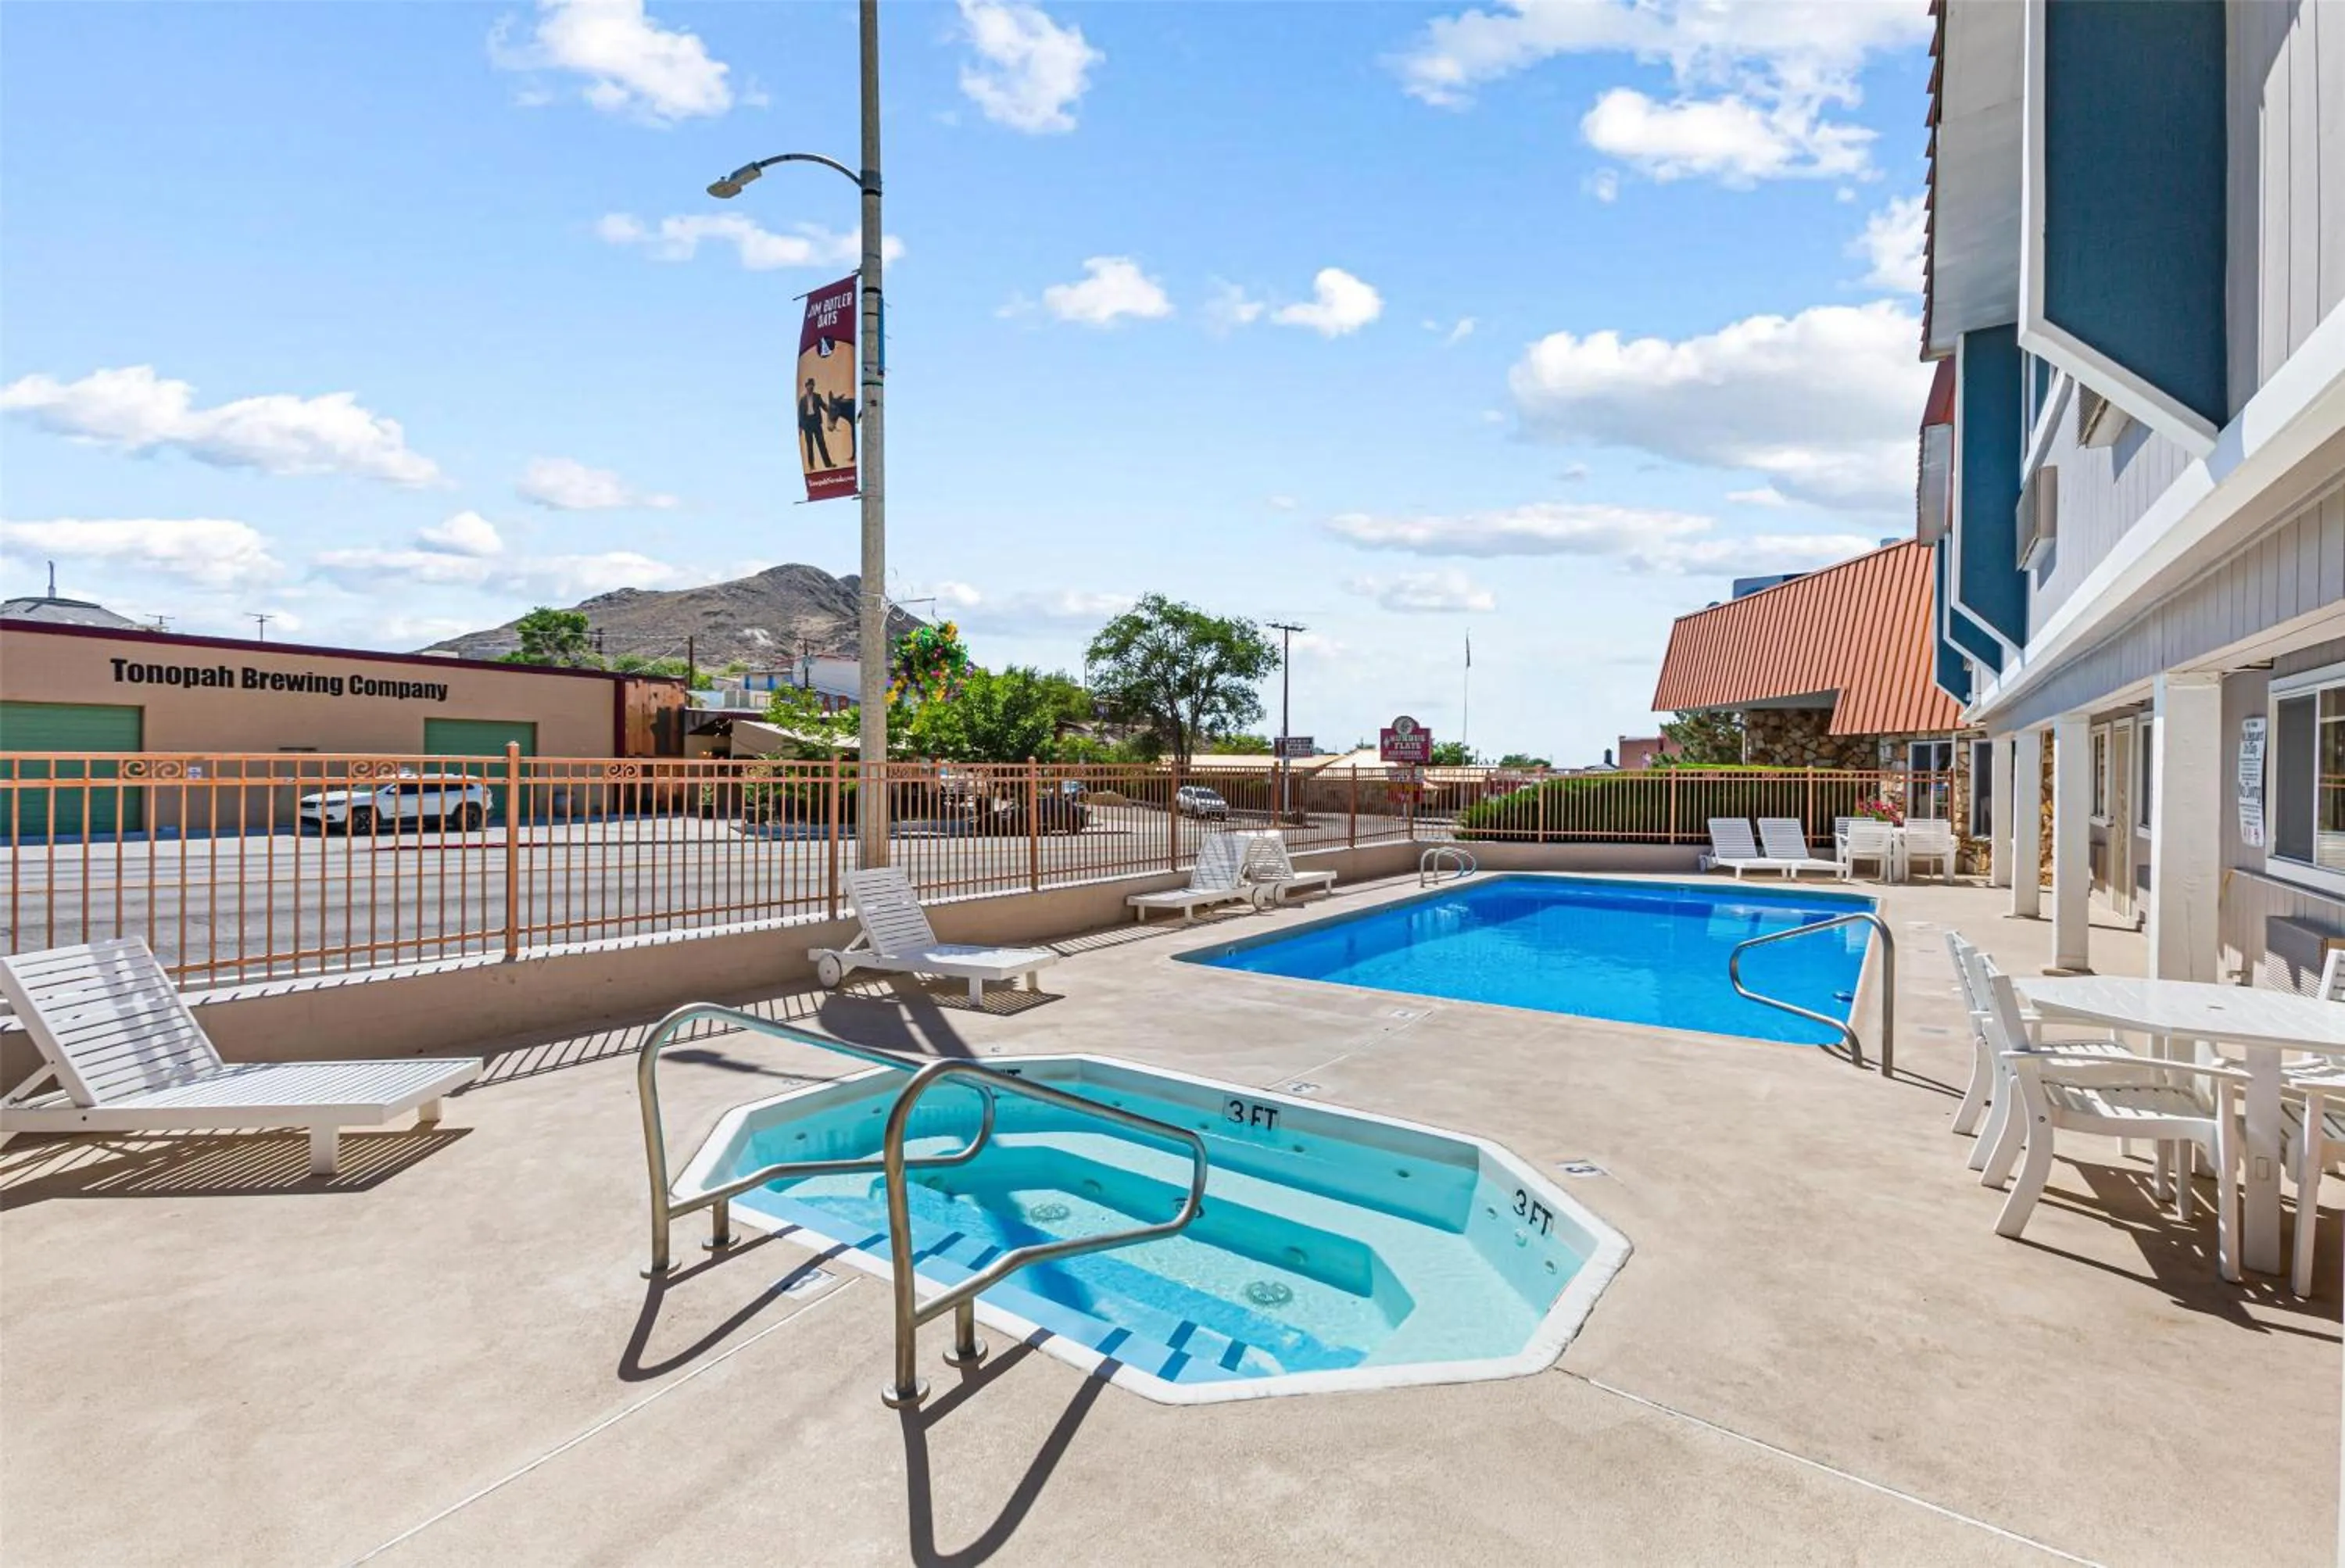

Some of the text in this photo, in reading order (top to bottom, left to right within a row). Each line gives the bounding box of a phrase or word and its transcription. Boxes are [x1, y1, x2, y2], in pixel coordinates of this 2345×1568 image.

[817, 310, 838, 328] DAYS
[110, 658, 448, 701] Tonopah Brewing Company
[1226, 1101, 1278, 1131] 3 FT
[1513, 1189, 1553, 1236] 3 FT
